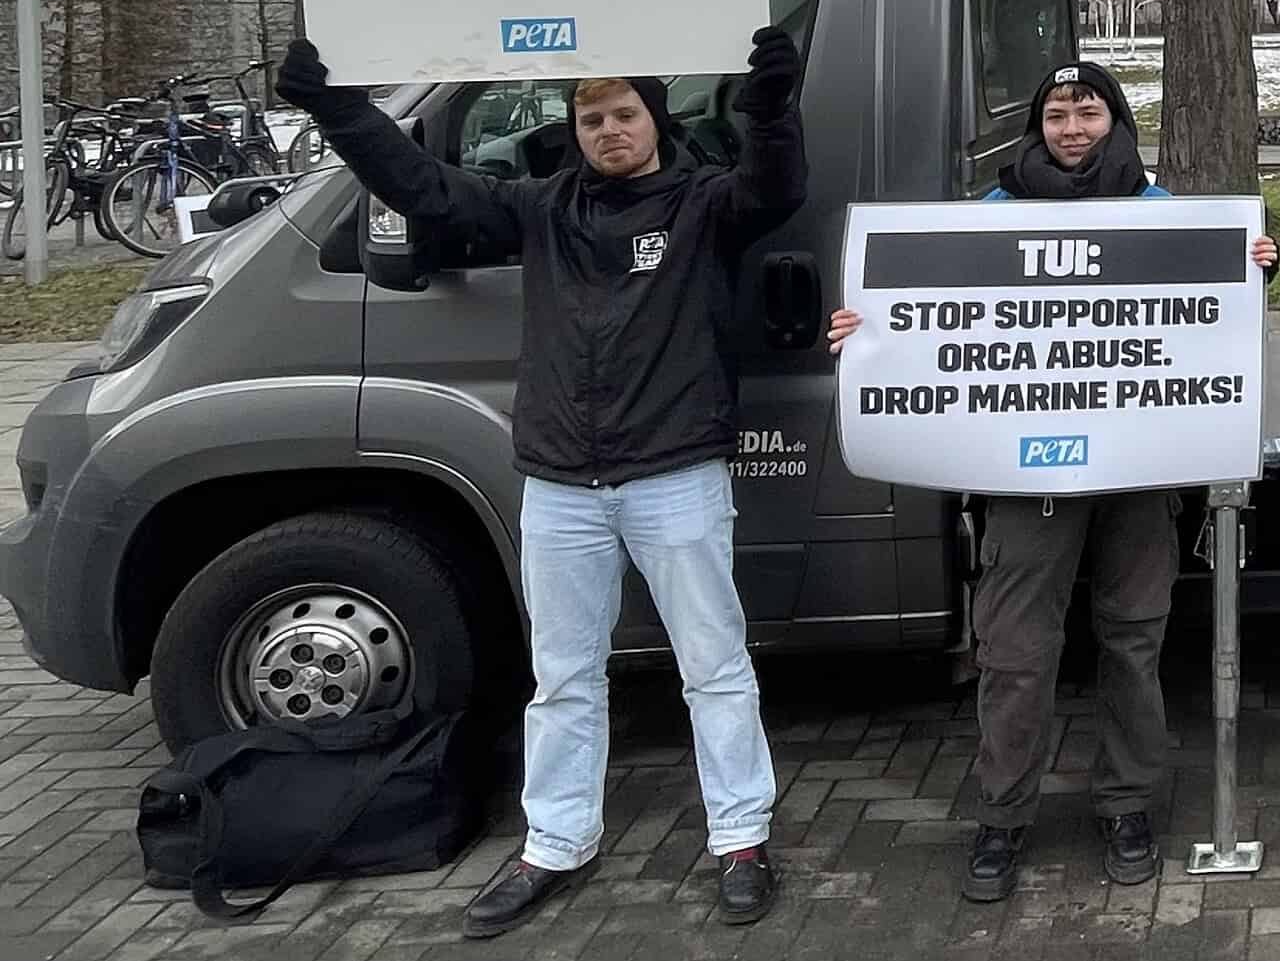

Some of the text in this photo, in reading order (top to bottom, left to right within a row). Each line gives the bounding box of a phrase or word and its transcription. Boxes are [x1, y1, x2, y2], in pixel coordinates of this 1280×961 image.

[889, 296, 1220, 332] STOP SUPPORTING
[937, 338, 1172, 373] ORCA ABUSE.
[860, 375, 1243, 416] DROP MARINE PARKS!
